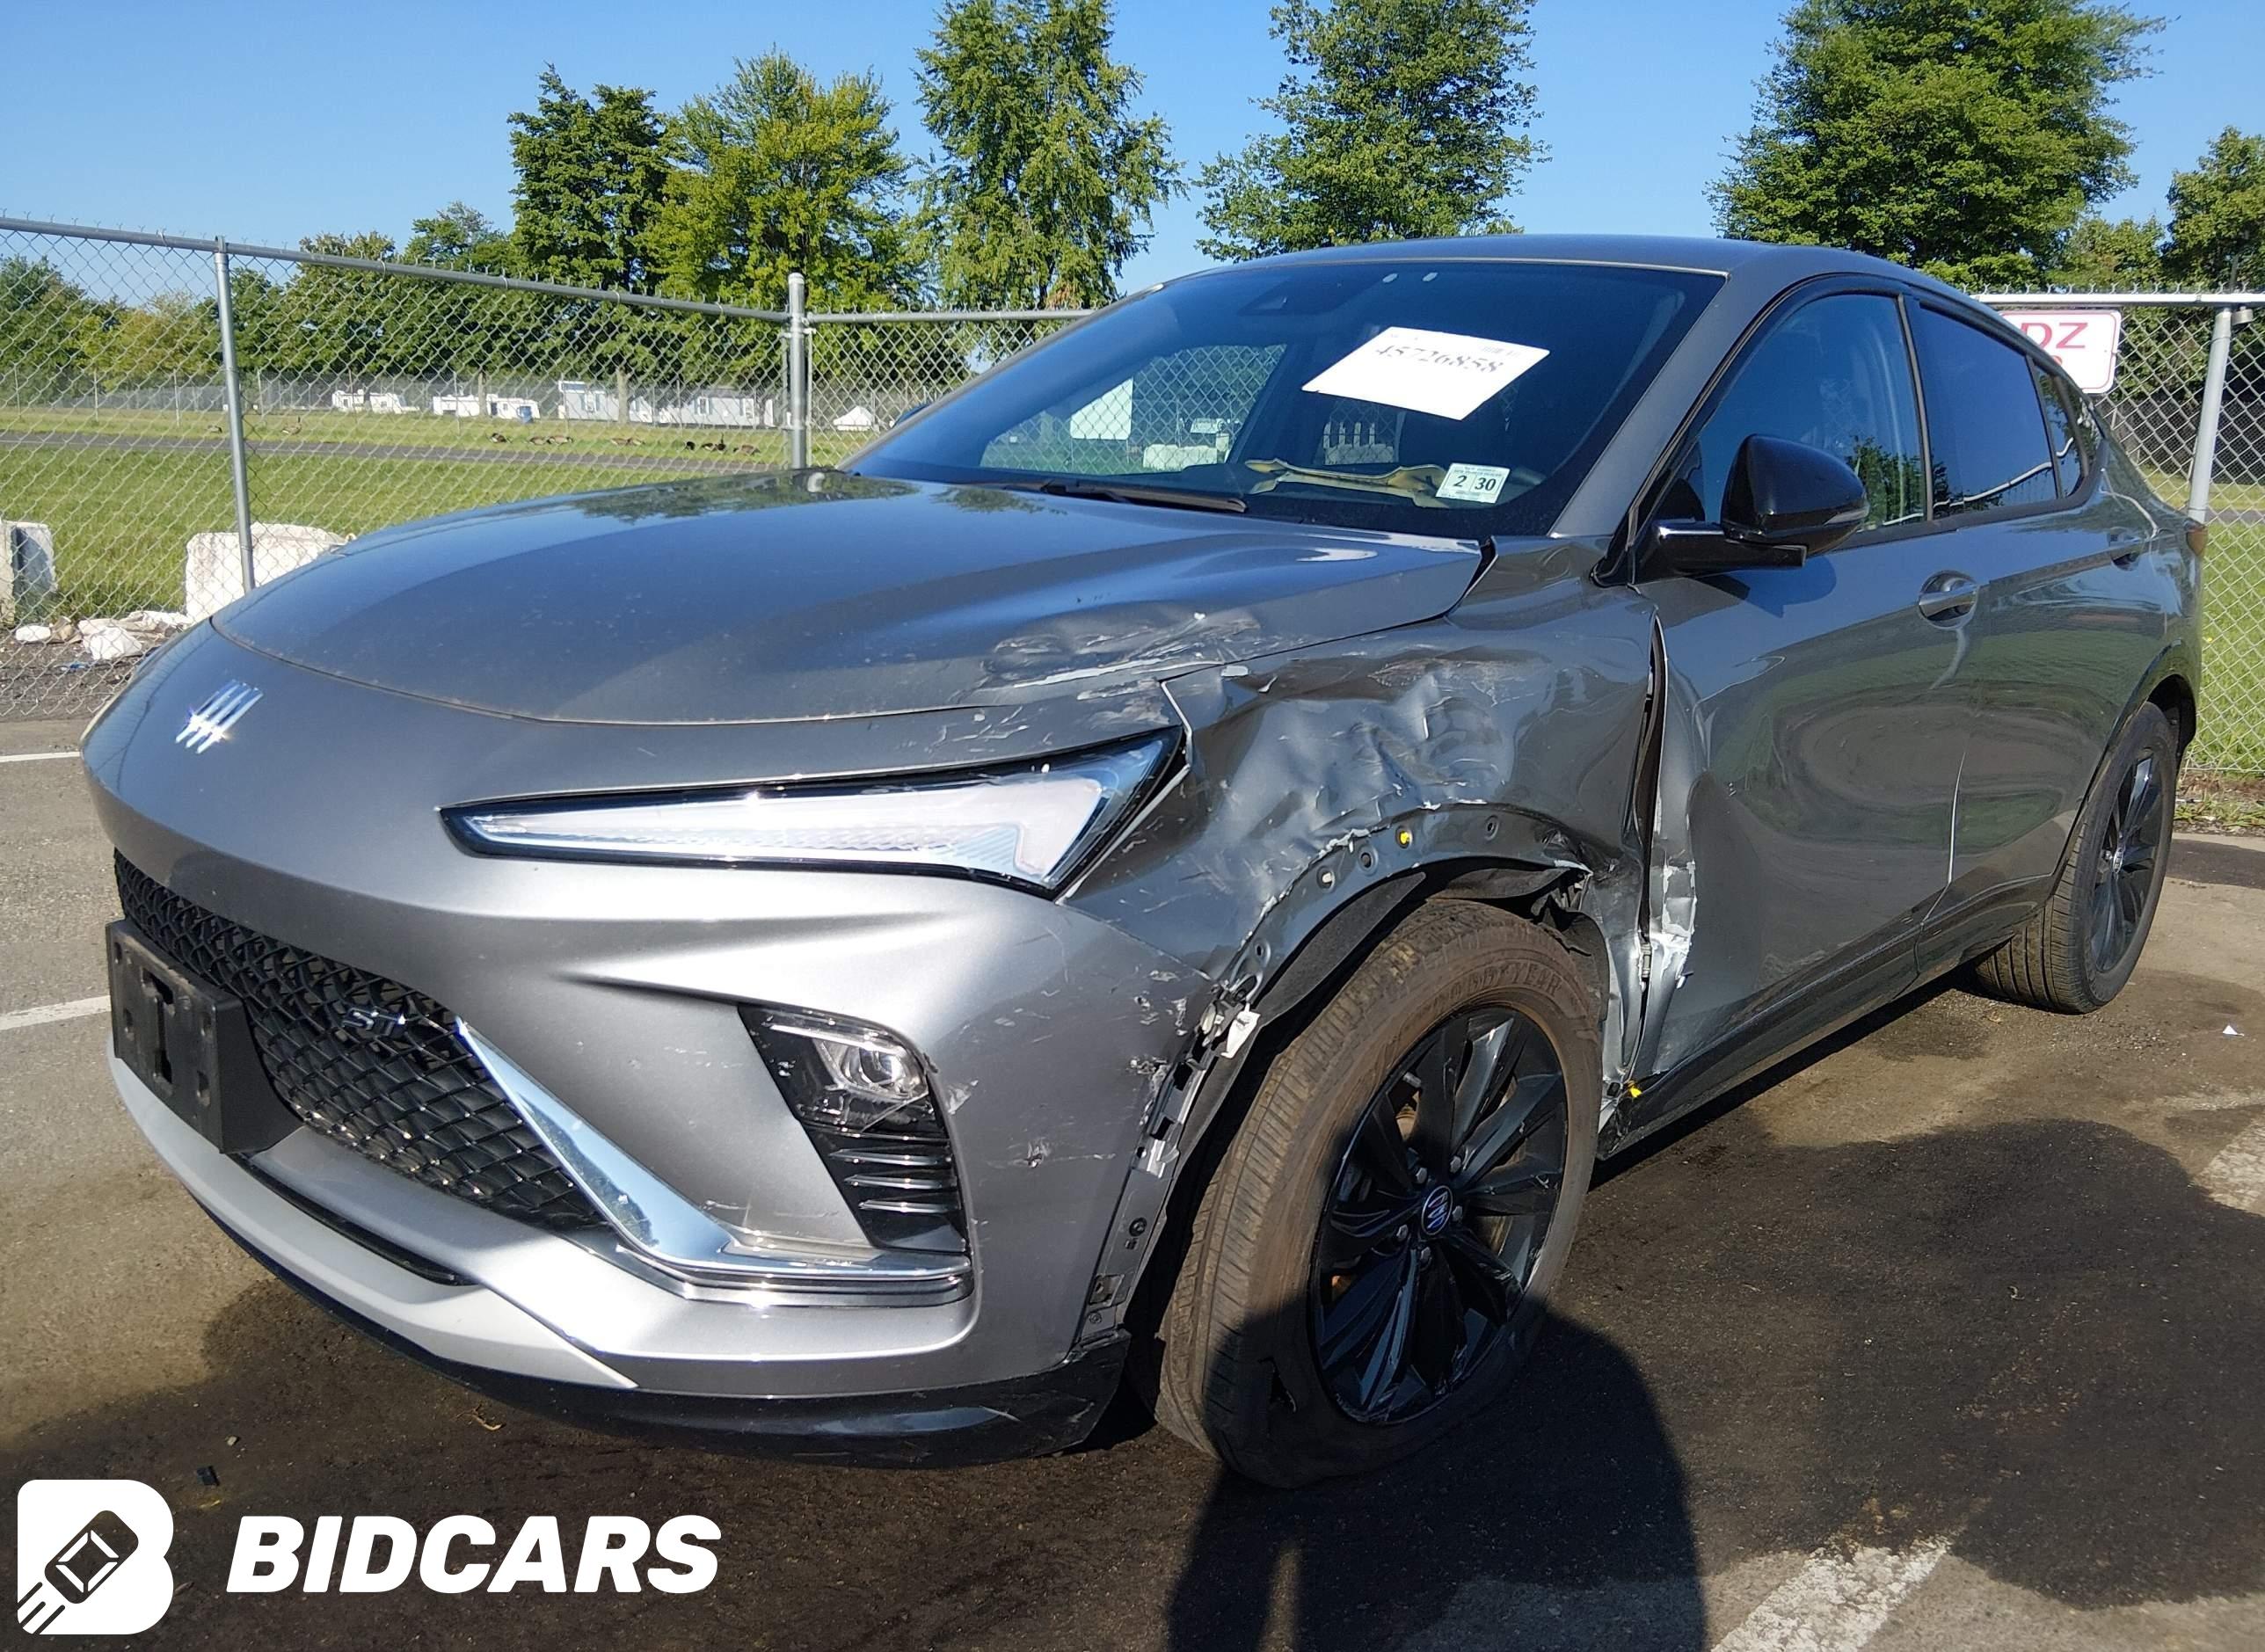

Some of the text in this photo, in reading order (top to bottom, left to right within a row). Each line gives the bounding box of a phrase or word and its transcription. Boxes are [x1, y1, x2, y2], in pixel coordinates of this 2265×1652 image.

[1453, 475, 1497, 491] 2 30
[1432, 959, 1562, 1013] OODYEAR
